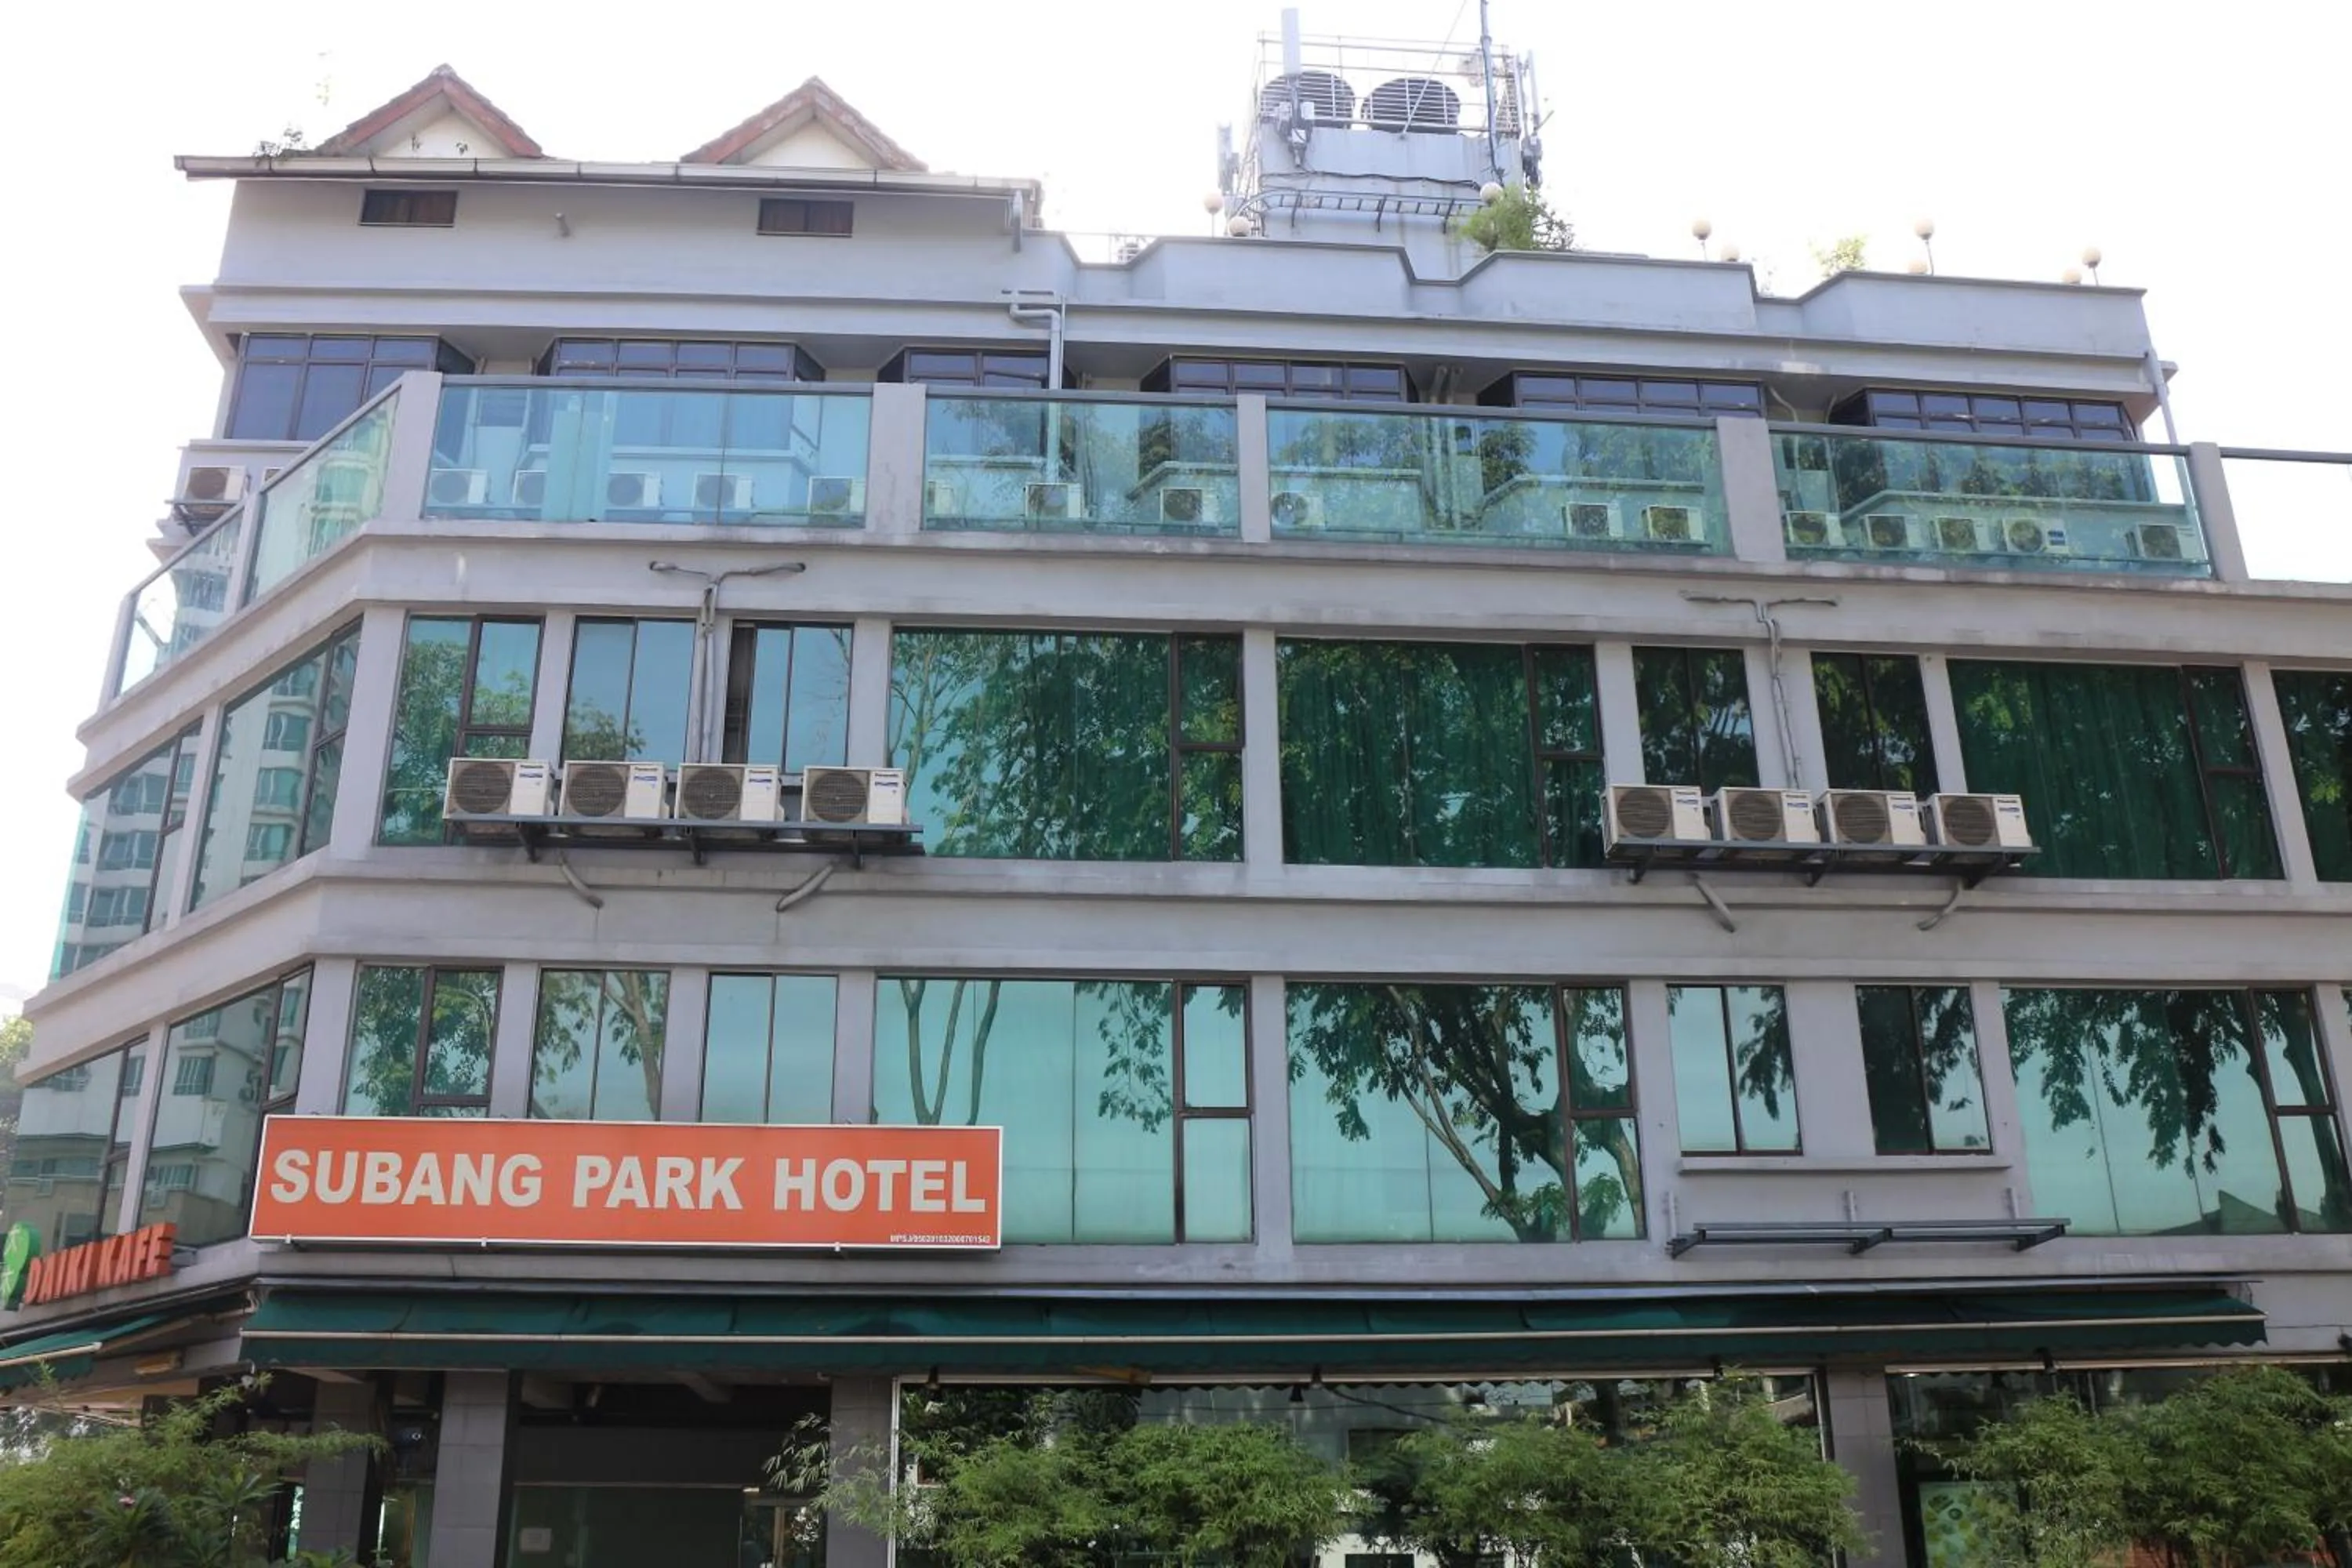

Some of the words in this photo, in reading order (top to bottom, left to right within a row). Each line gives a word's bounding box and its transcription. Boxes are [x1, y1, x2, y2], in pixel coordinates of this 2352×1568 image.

[270, 1149, 543, 1207] SUBANG
[572, 1154, 745, 1210] PARK
[774, 1157, 986, 1213] HOTEL
[24, 1241, 94, 1305] DAIKI
[96, 1223, 168, 1286] KAFE
